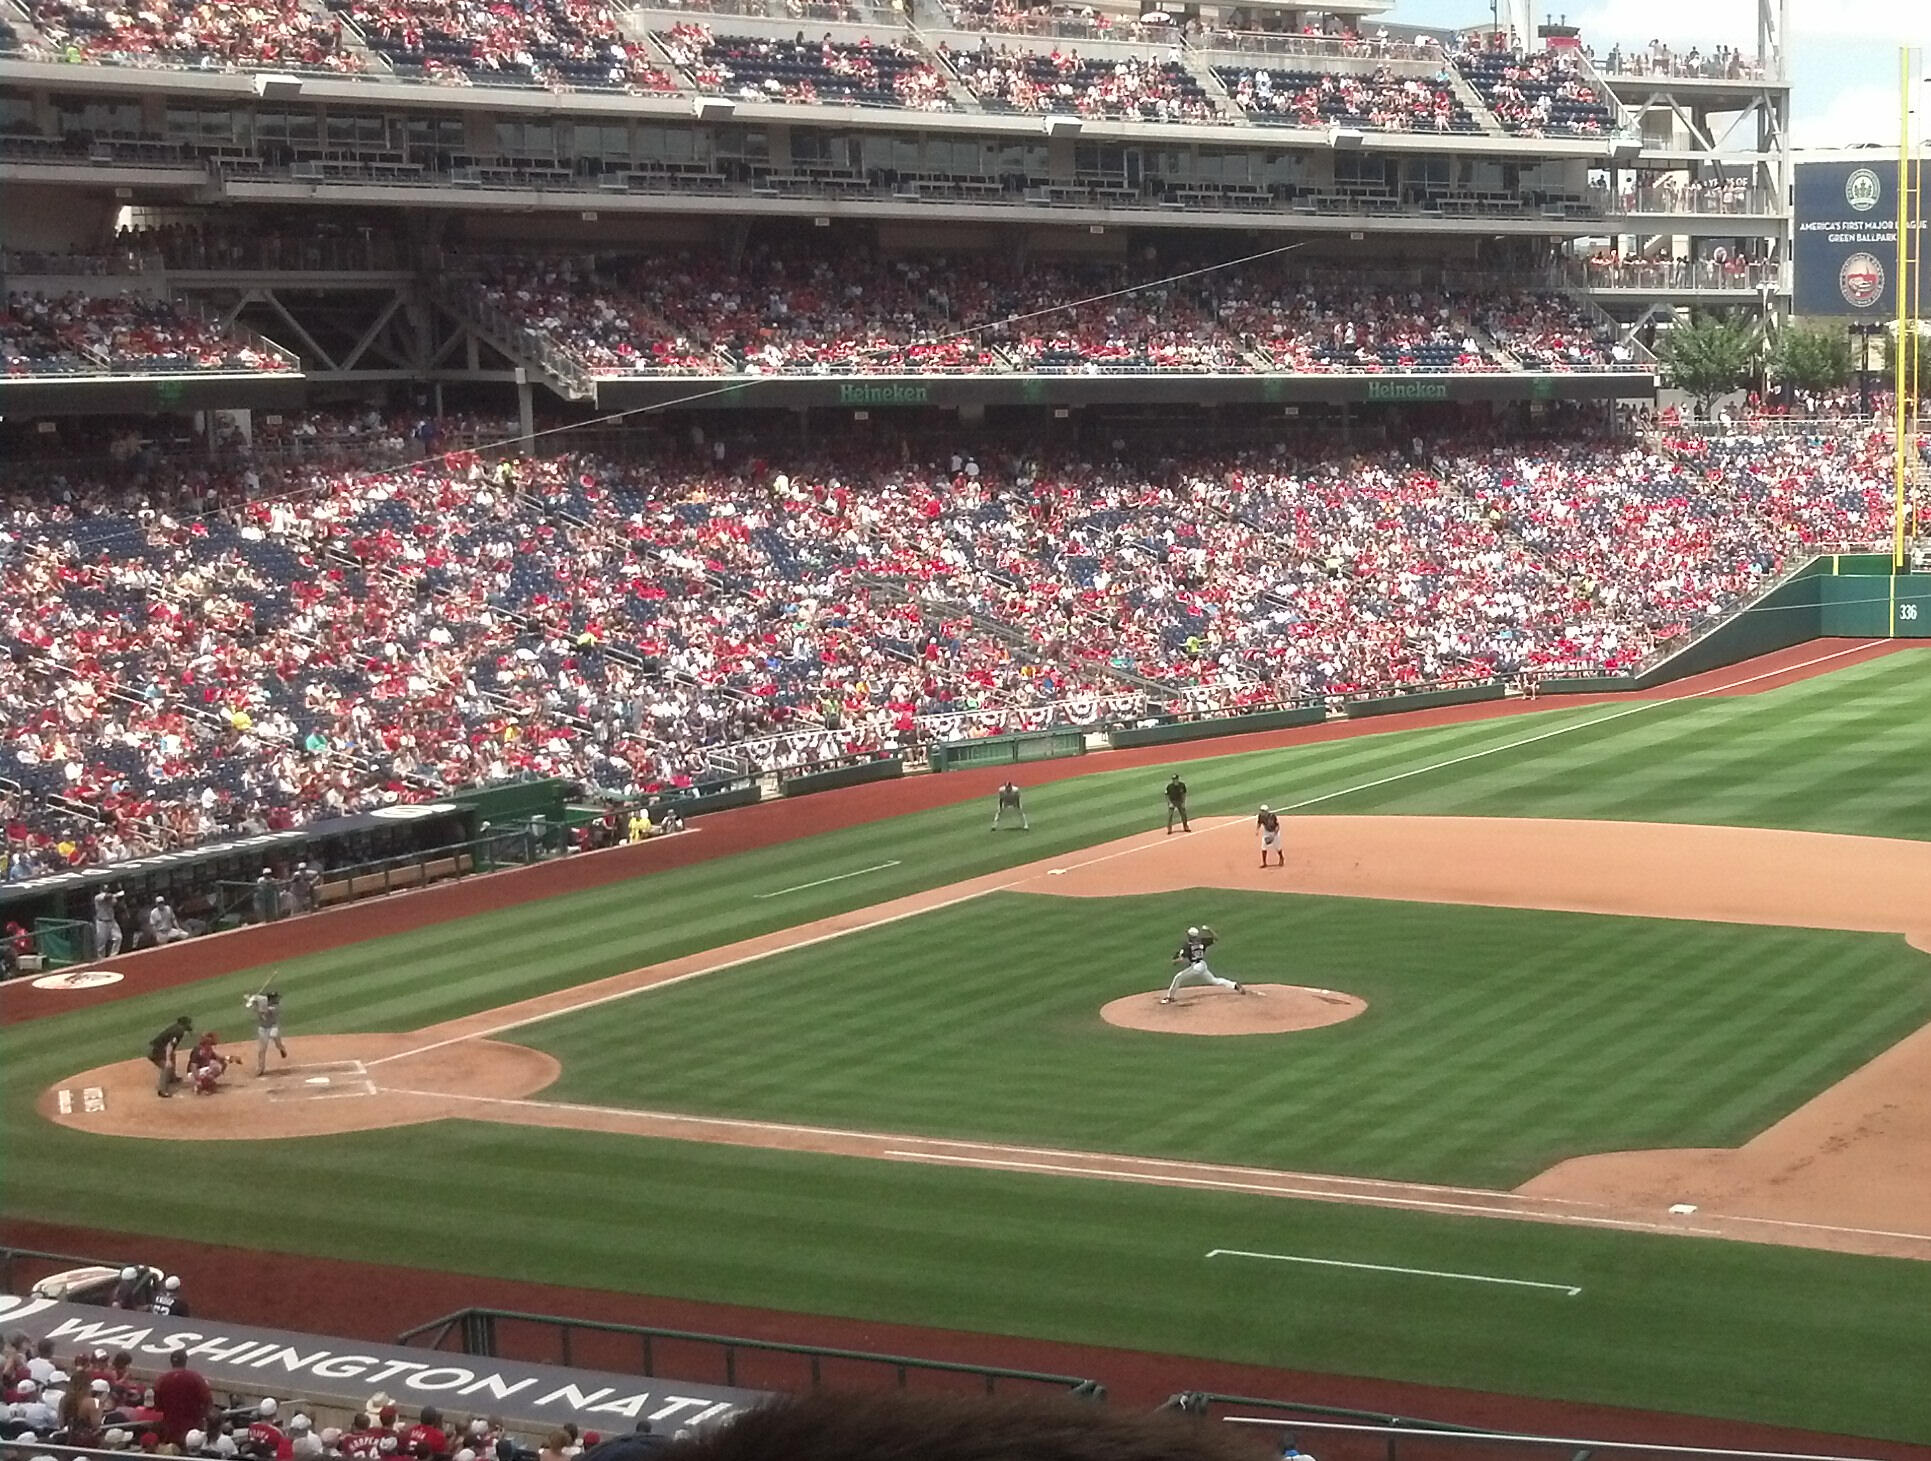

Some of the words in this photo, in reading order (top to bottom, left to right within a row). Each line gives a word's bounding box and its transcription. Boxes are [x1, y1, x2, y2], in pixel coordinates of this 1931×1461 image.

[1799, 221, 1840, 231] AMERICA'S
[1842, 221, 1864, 230] FIRST
[1864, 220, 1894, 230] MAJOR
[1828, 233, 1856, 242] GREEN
[1856, 233, 1897, 242] BALLPARK
[840, 383, 928, 402] Heineken
[1367, 381, 1447, 399] Heineken
[1899, 603, 1918, 620] 336
[44, 1318, 539, 1399] WASHINGTON
[533, 1384, 752, 1425] NATI
